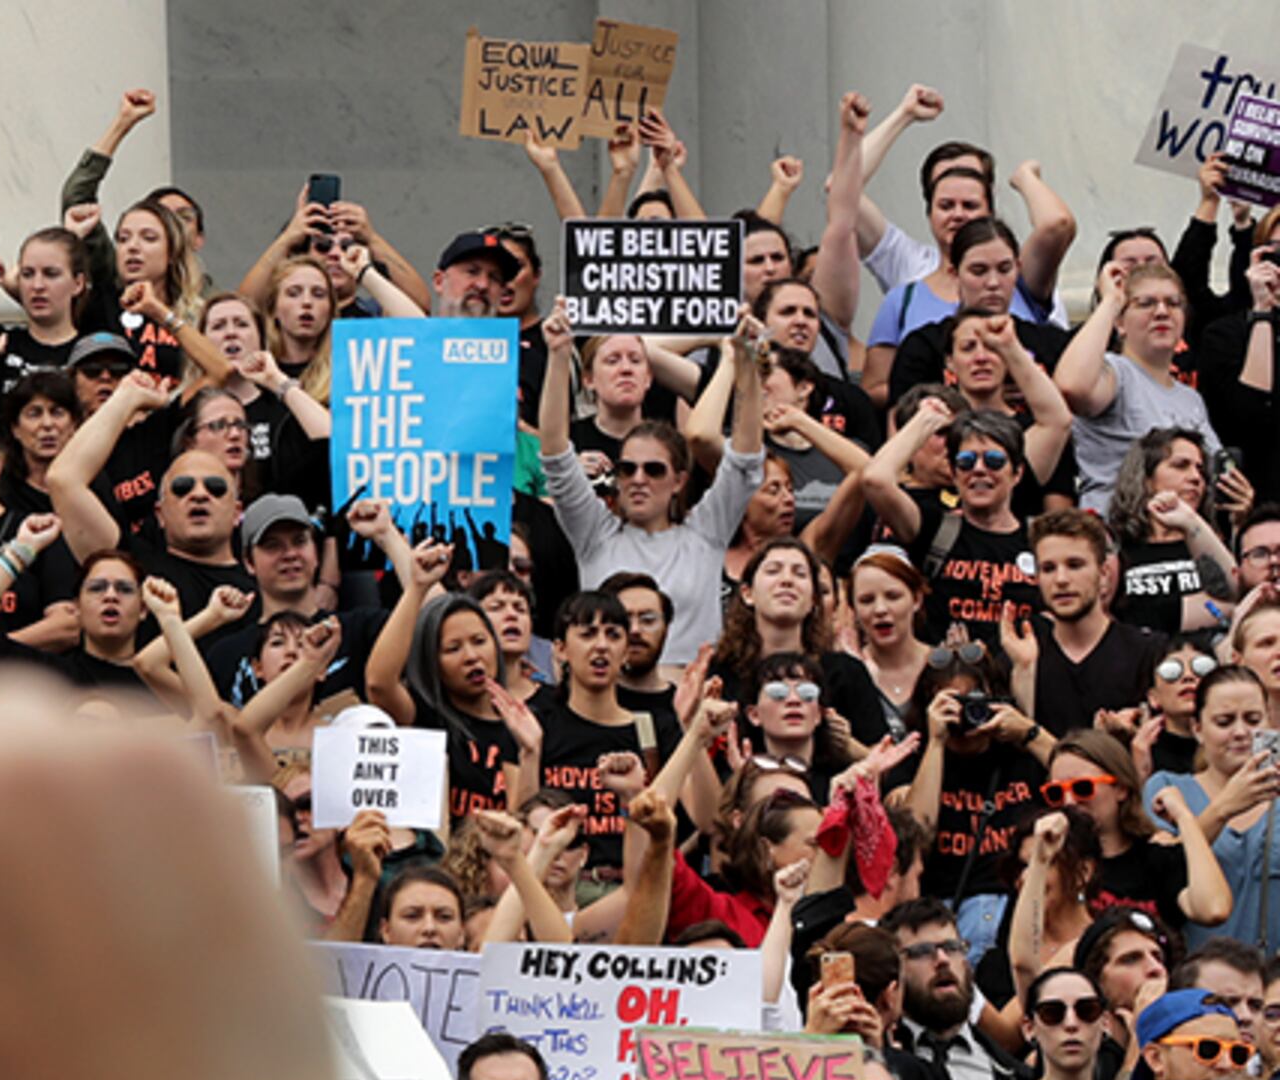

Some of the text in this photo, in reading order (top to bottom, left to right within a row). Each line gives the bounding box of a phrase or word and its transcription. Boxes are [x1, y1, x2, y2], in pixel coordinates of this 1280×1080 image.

[478, 67, 576, 96] JUSTICE
[582, 78, 648, 122] ALL
[576, 230, 728, 256] WE BELIEVE
[583, 264, 721, 291] CHRISTINE
[566, 298, 738, 326] BLASEY FORD
[348, 338, 414, 391] WE
[446, 339, 506, 362] ACLU
[345, 396, 424, 449] THE
[347, 454, 498, 505] PEOPLE
[358, 736, 399, 756] THIS
[352, 762, 399, 782] AIN'T
[351, 788, 398, 807] OVER
[521, 948, 728, 986] HEY, COLLINS:
[338, 957, 481, 1046] VOTE
